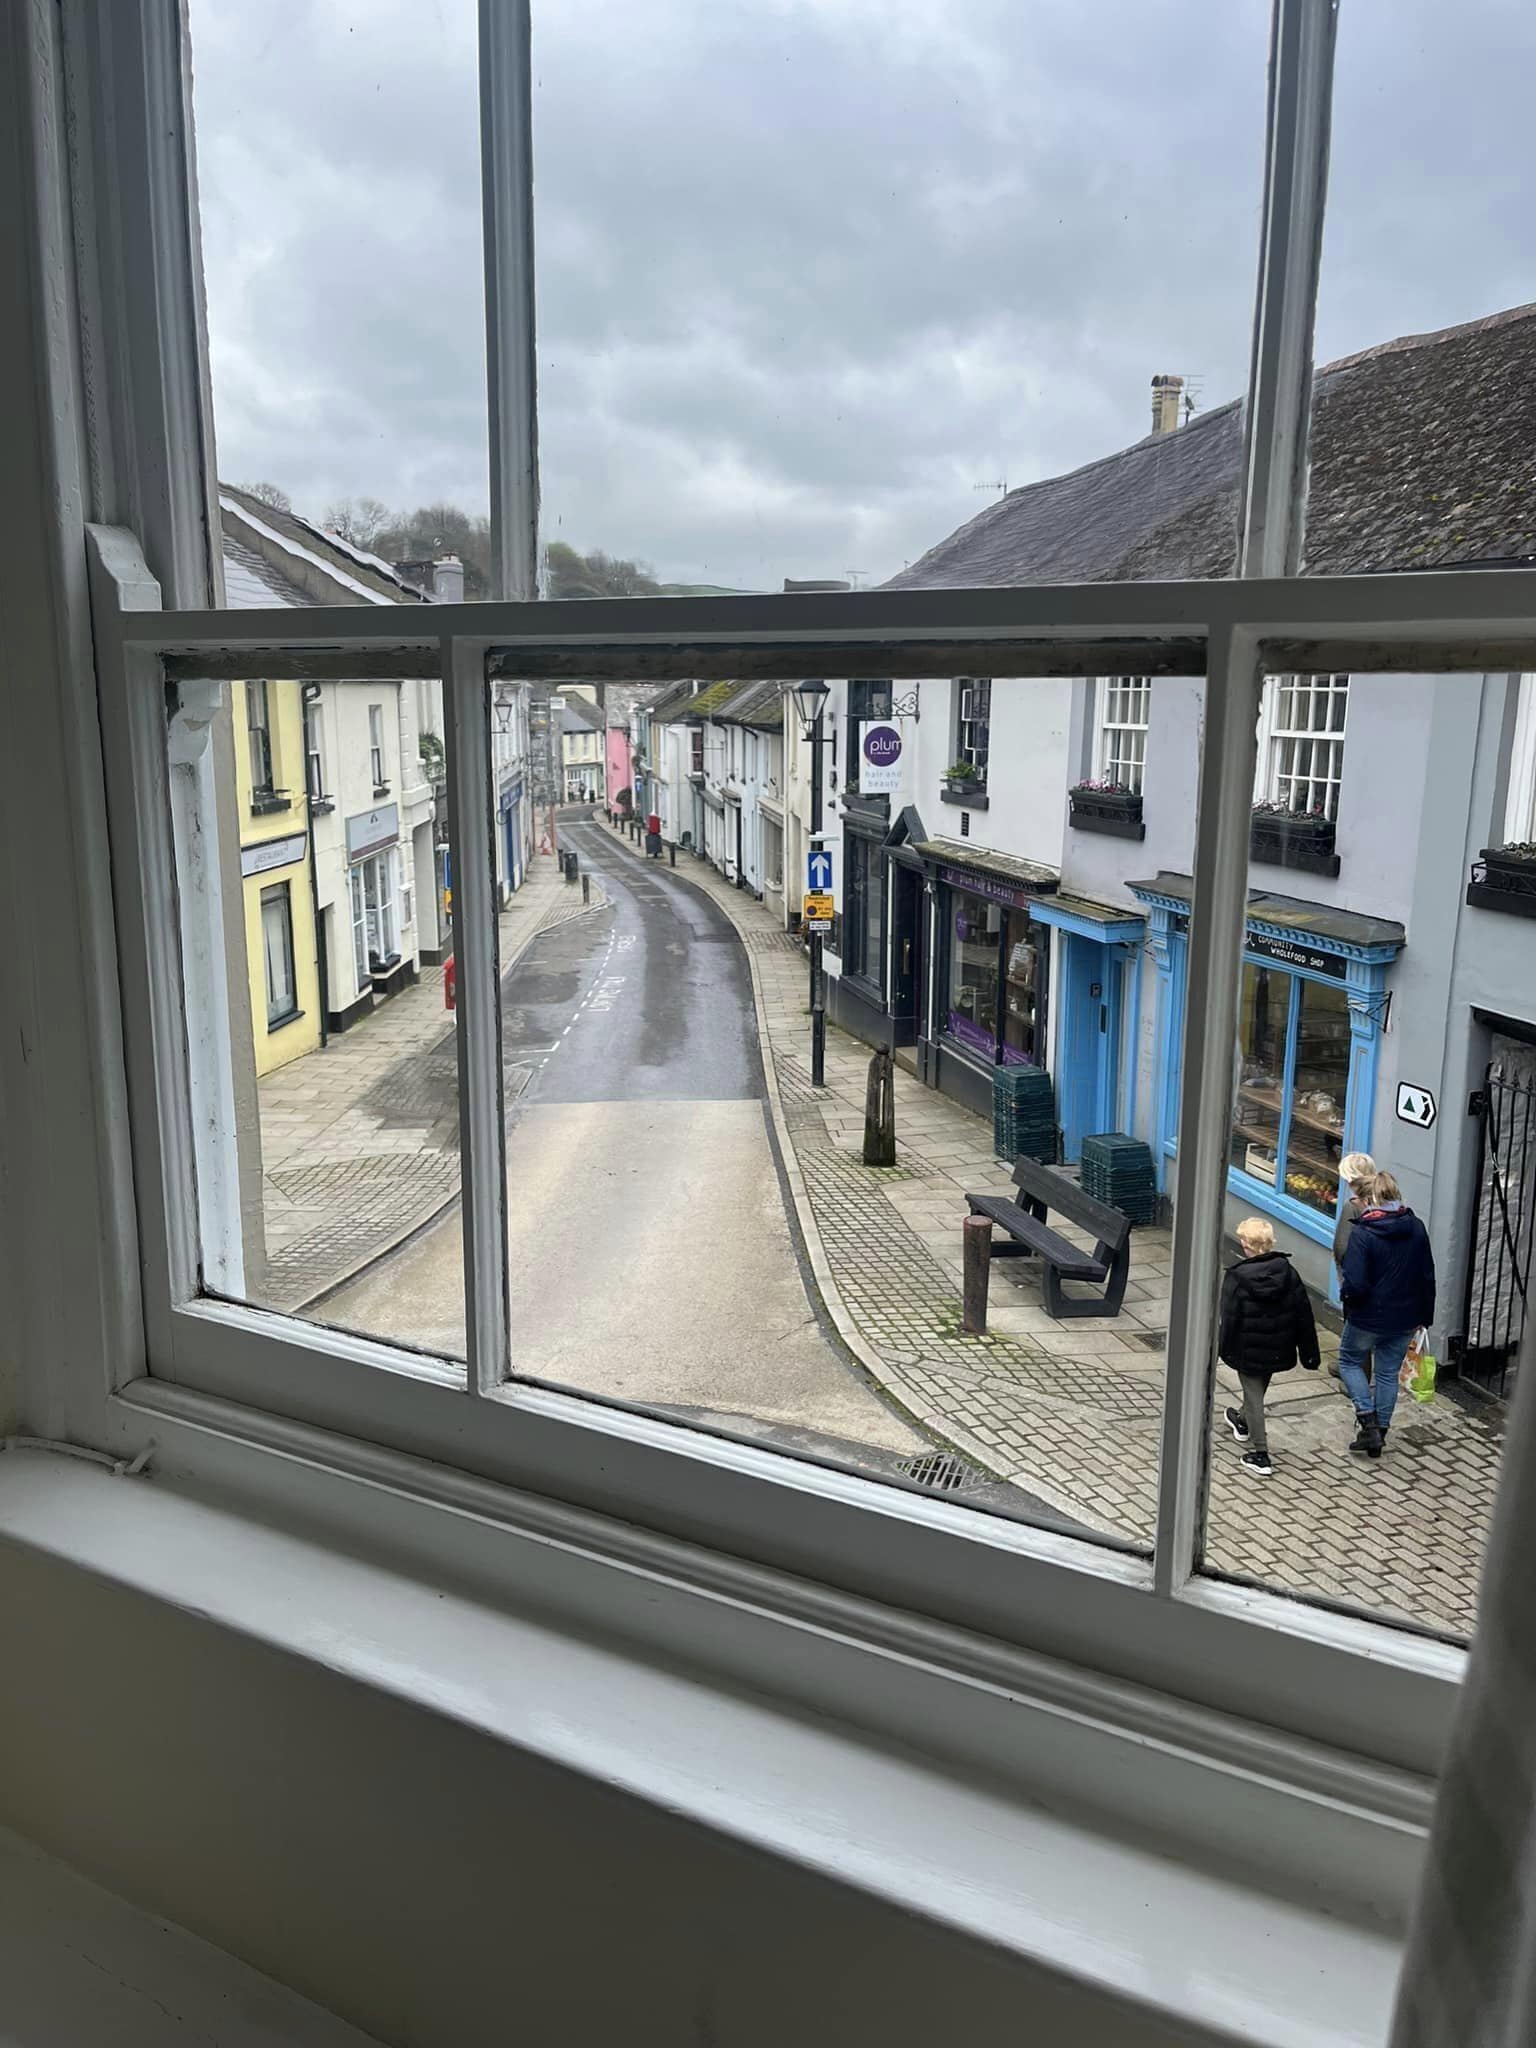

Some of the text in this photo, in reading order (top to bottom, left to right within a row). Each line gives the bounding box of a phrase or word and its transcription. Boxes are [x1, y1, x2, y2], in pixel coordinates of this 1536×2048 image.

[871, 737, 901, 755] plum
[868, 780, 899, 788] beauty
[1270, 946, 1325, 968] WHOLEFOOD SHOP
